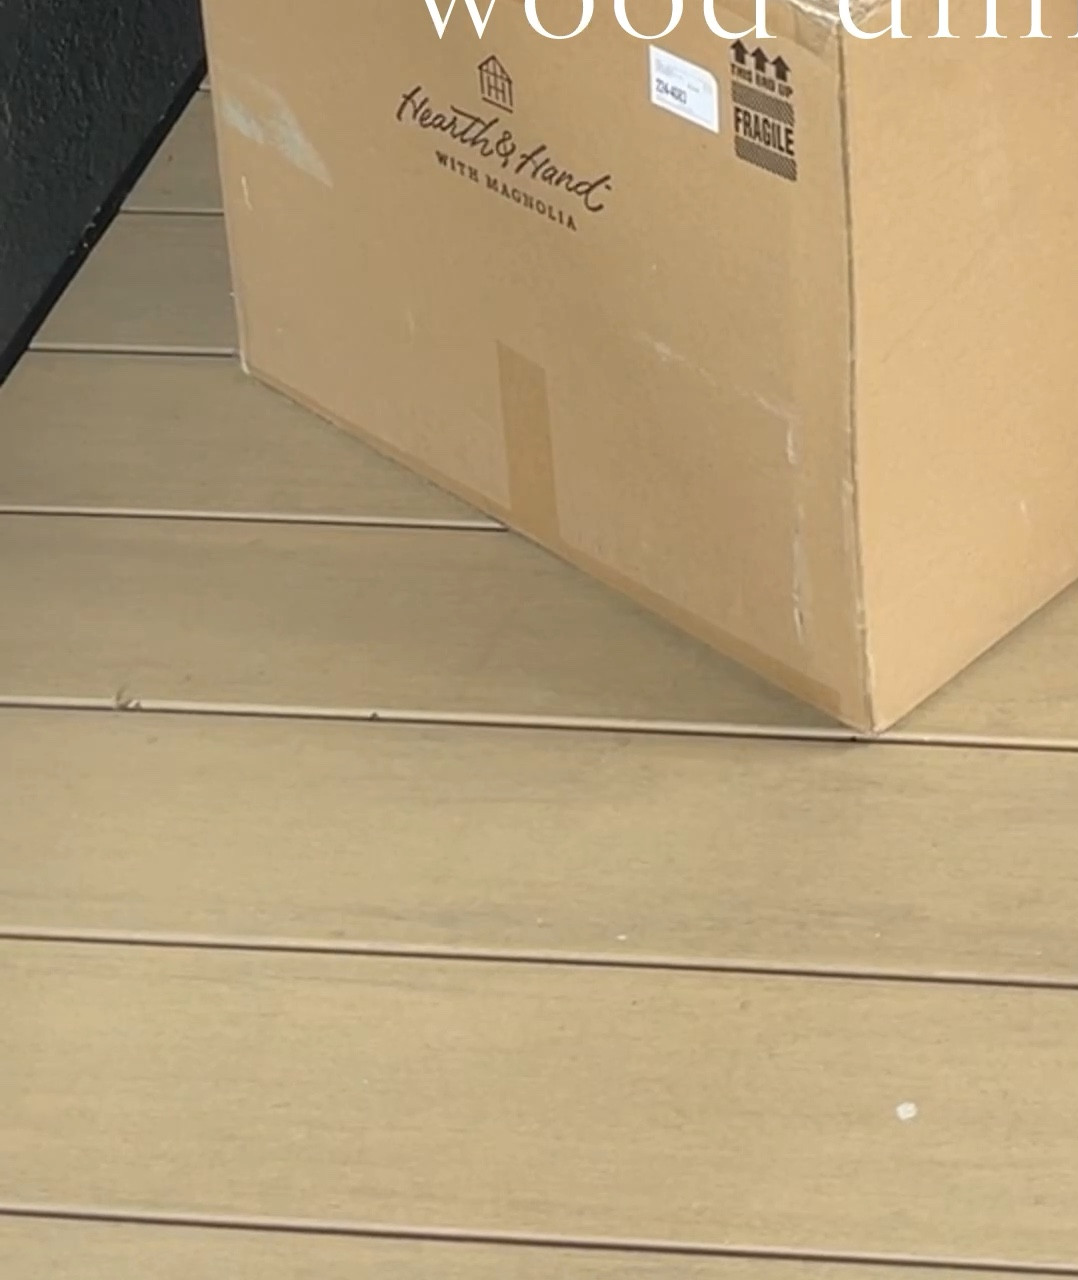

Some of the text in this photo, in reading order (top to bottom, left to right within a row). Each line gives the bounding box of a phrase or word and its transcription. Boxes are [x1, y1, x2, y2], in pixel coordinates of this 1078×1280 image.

[730, 62, 794, 99] THIS END UP
[396, 86, 500, 157] Hearth
[514, 144, 611, 212] Hand
[733, 105, 796, 157] FRAGILE
[435, 150, 578, 231] WITH MAGNOLIA
